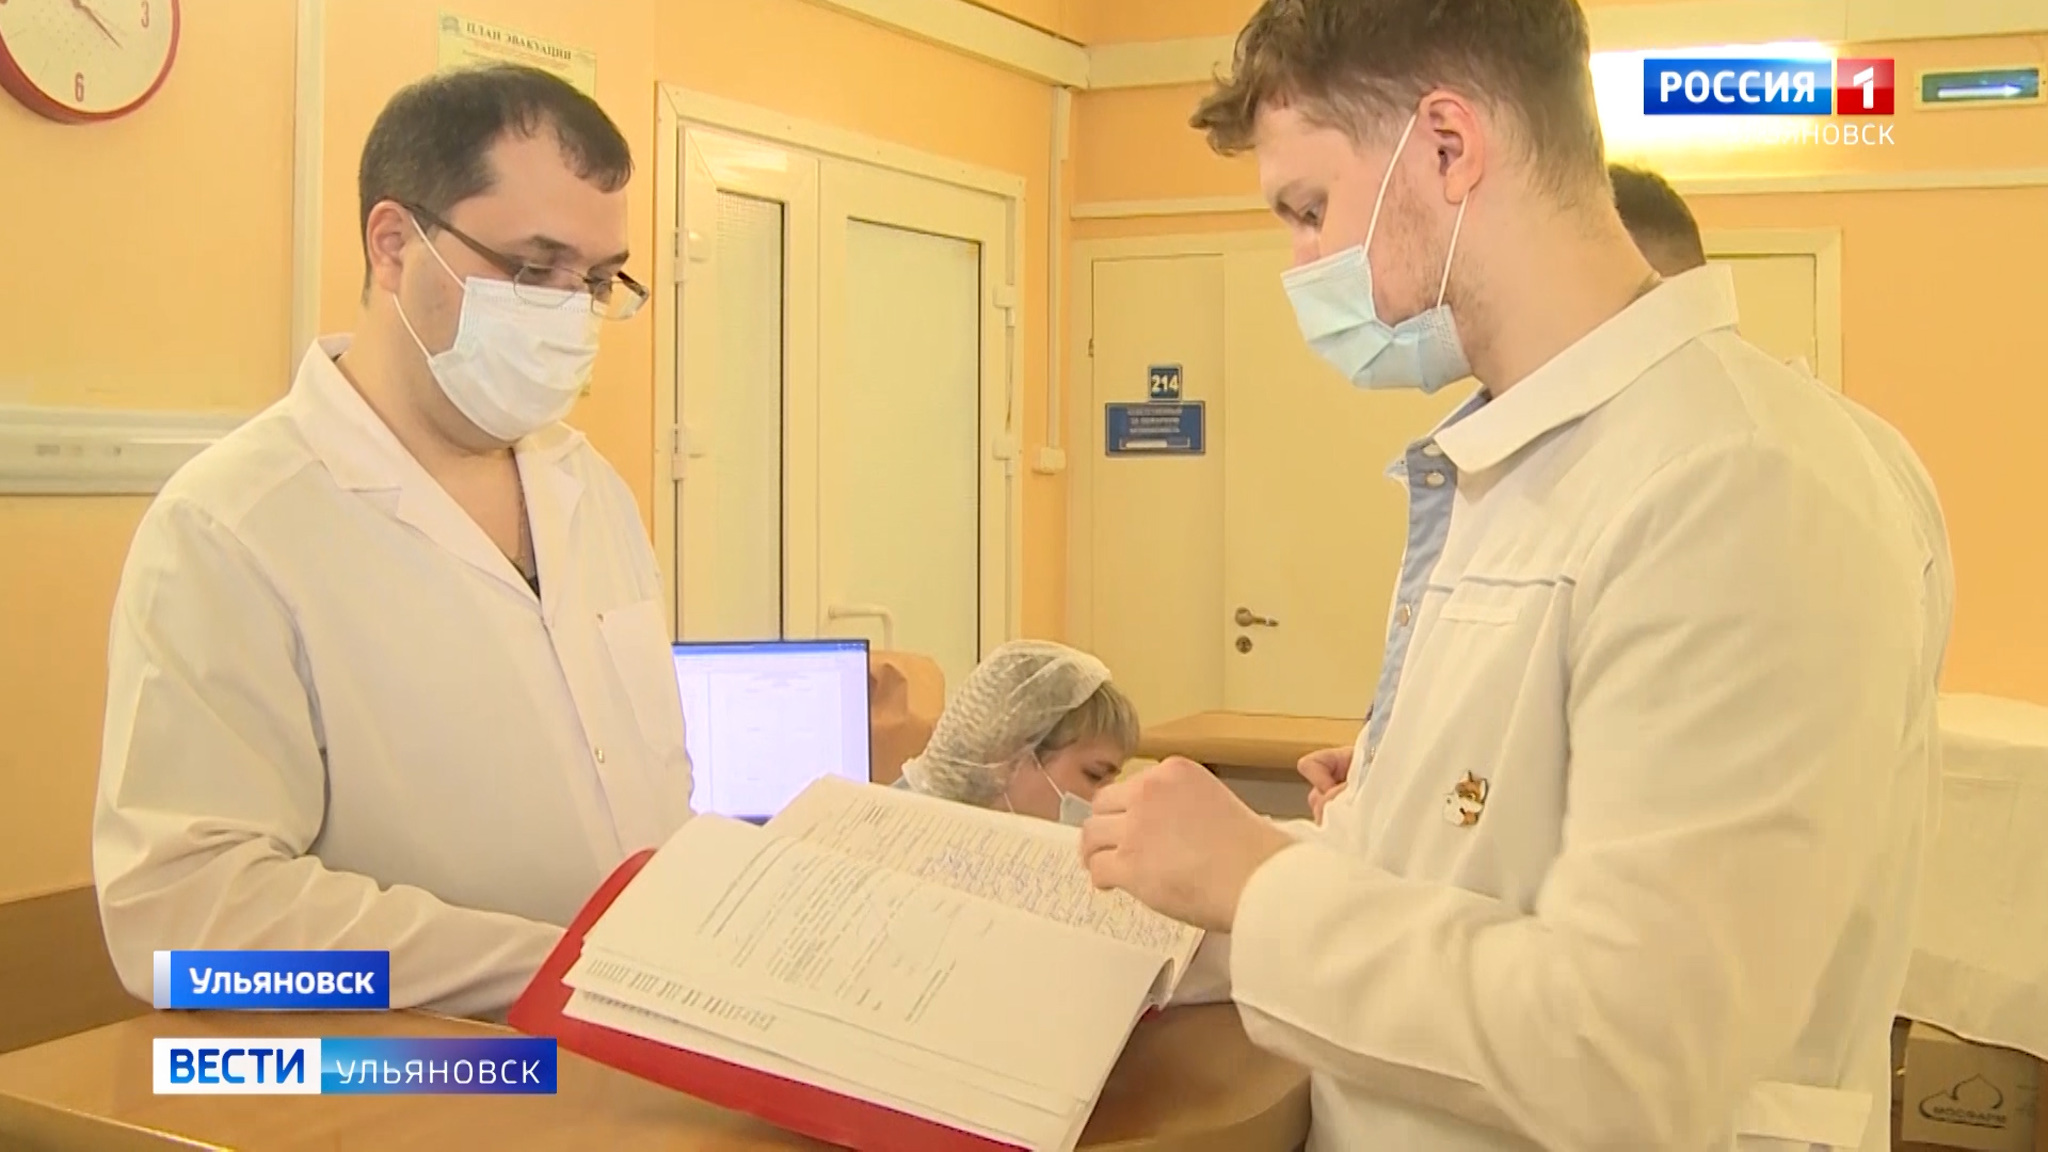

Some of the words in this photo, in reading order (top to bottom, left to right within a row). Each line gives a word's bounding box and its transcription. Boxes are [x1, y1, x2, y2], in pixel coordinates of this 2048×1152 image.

[141, 1, 149, 28] 3
[466, 22, 501, 41] ПЛАН
[507, 33, 572, 60] ЭВАКУАЦИИ
[75, 72, 84, 102] 6
[1151, 374, 1179, 393] 214
